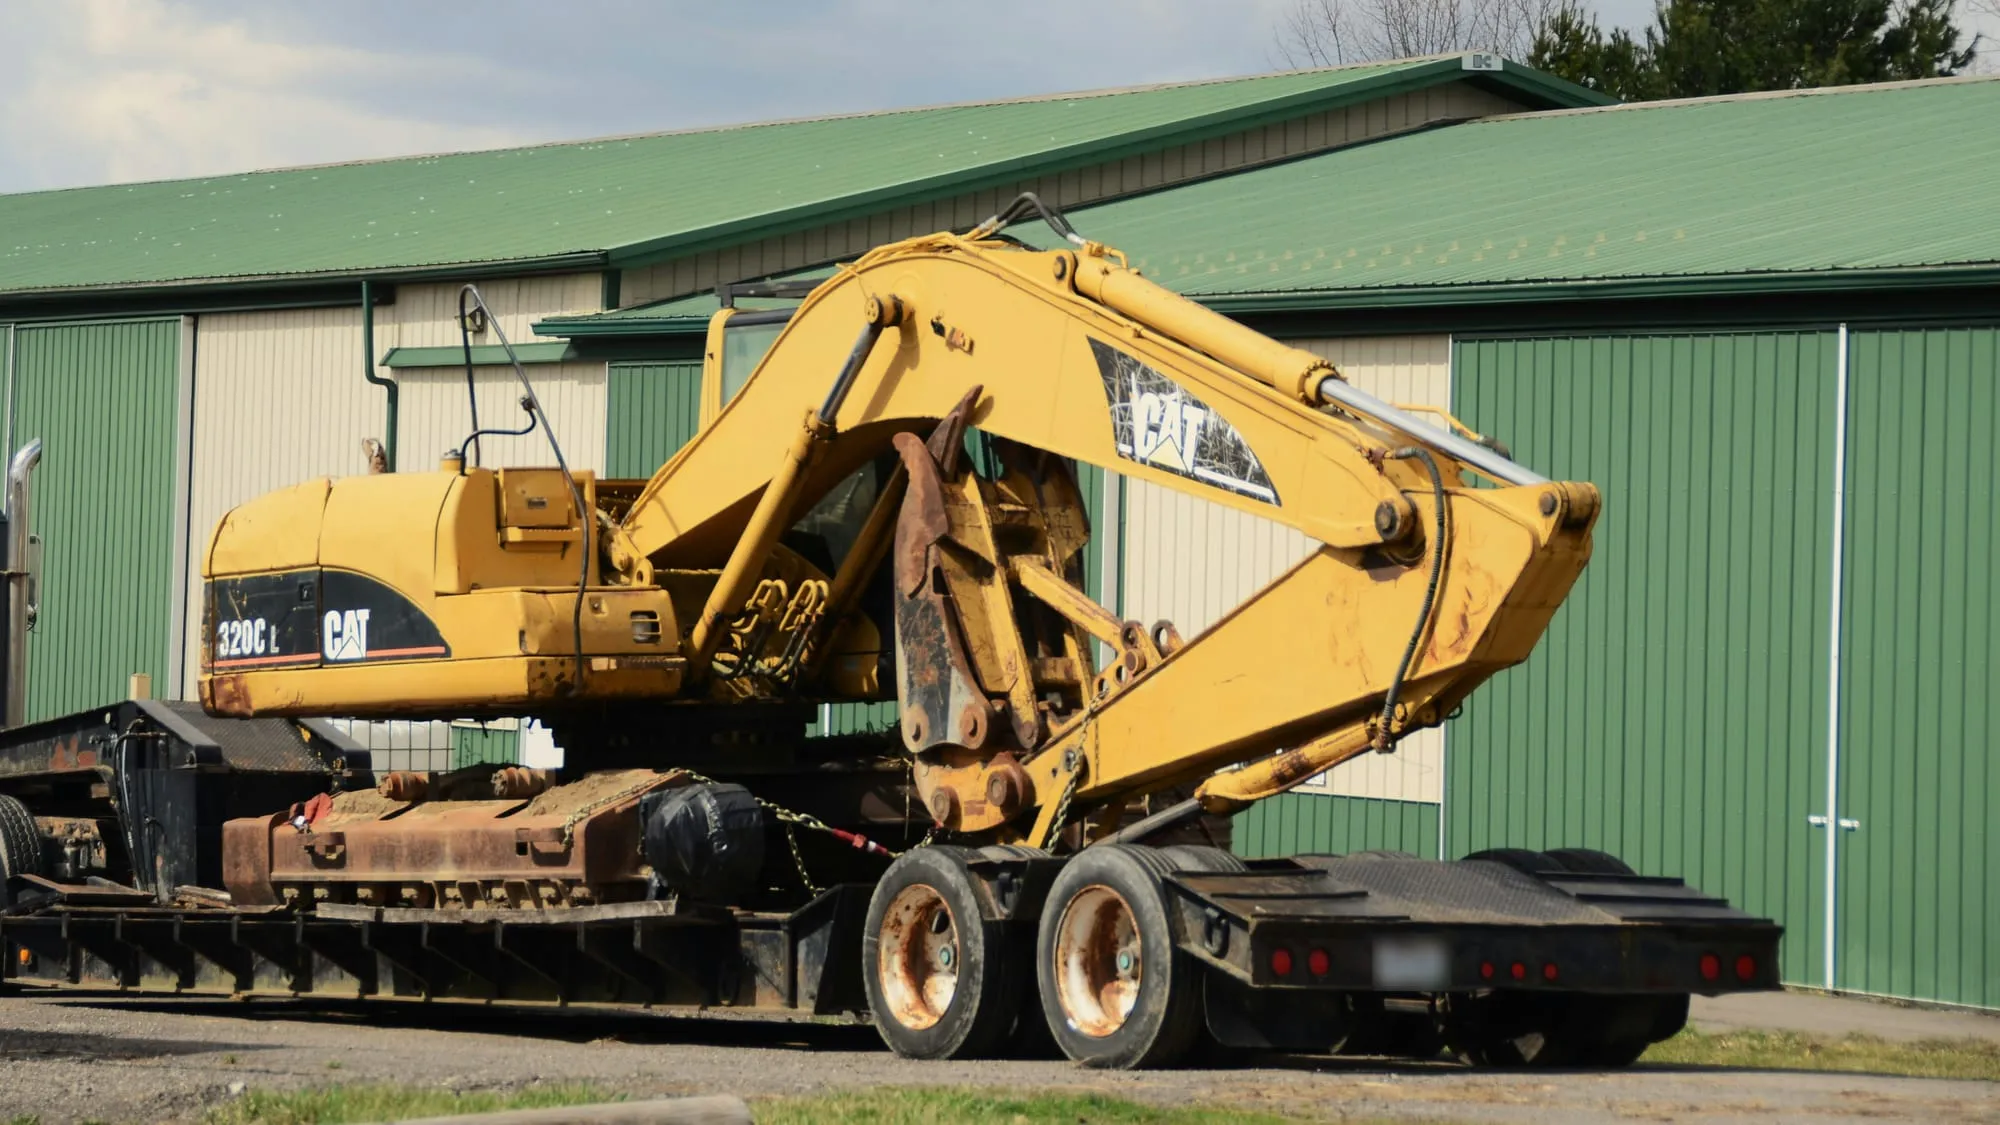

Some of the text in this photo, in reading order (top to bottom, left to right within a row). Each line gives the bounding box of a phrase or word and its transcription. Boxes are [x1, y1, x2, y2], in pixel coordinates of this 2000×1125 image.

[1133, 392, 1205, 473] CAT
[217, 618, 280, 657] 320C L
[323, 608, 371, 660] CAT
